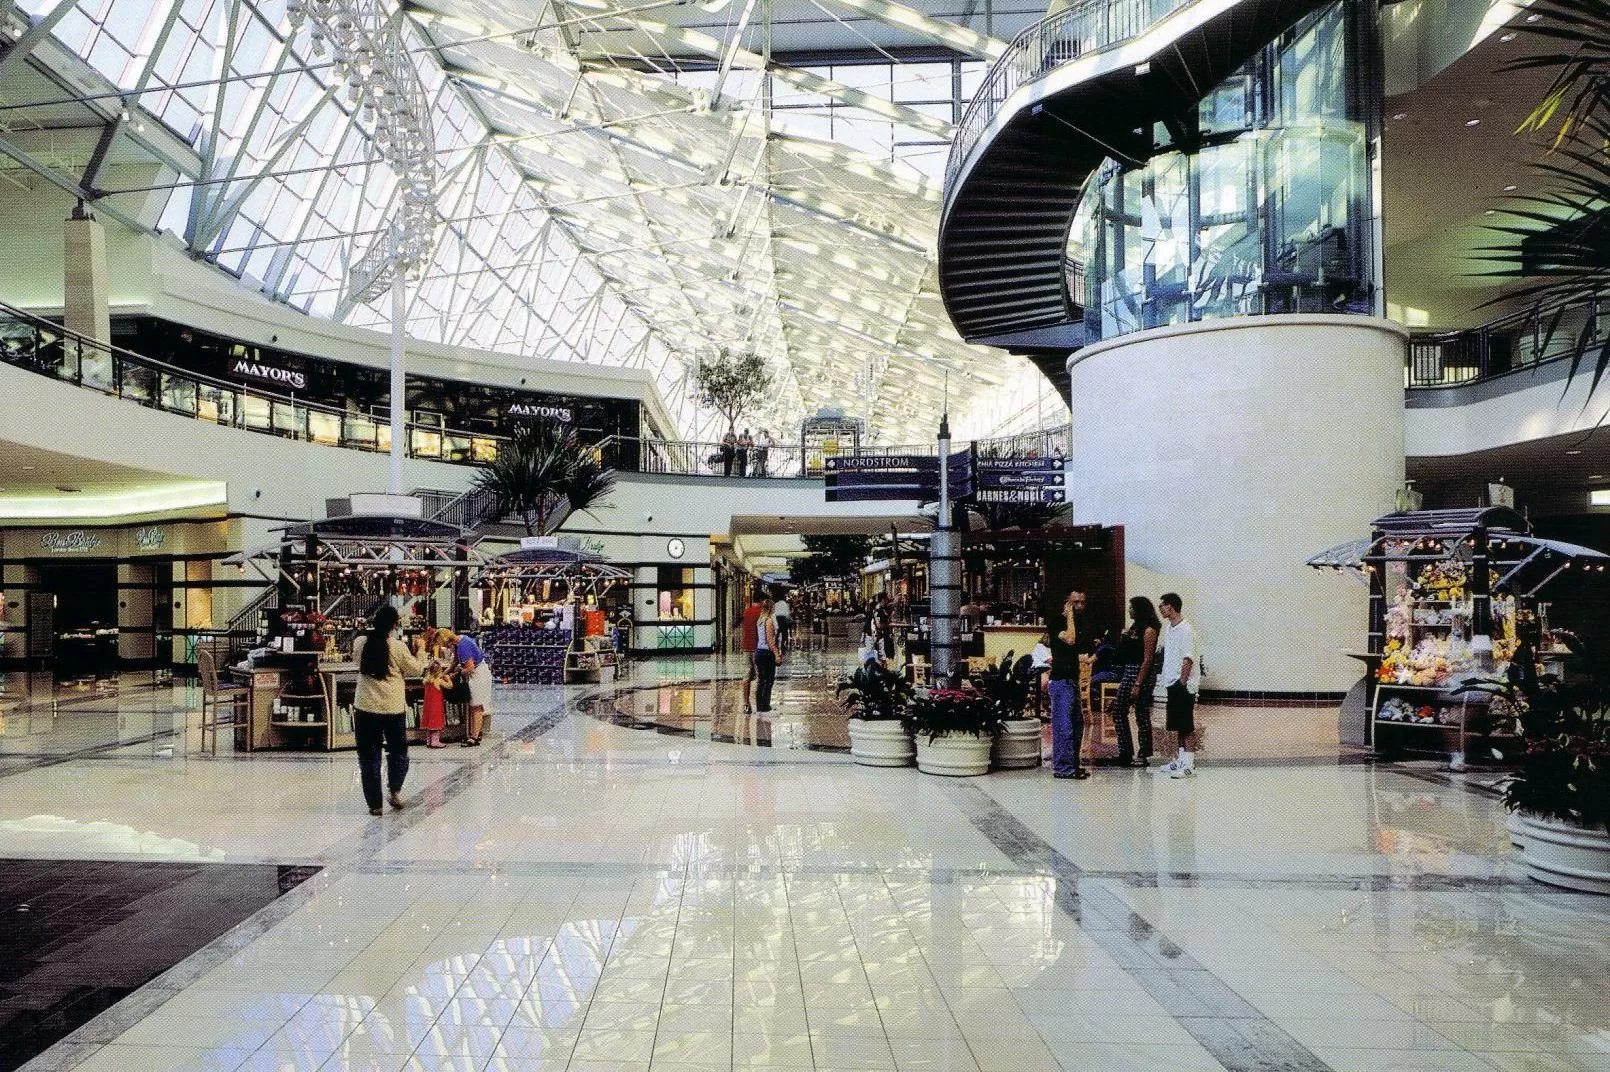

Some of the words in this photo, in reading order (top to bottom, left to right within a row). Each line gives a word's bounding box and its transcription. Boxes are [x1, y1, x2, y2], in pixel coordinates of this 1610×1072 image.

[233, 361, 306, 388] MAYOR'S
[508, 404, 572, 422] MAYOR'S
[843, 458, 909, 467] NORDSTROM
